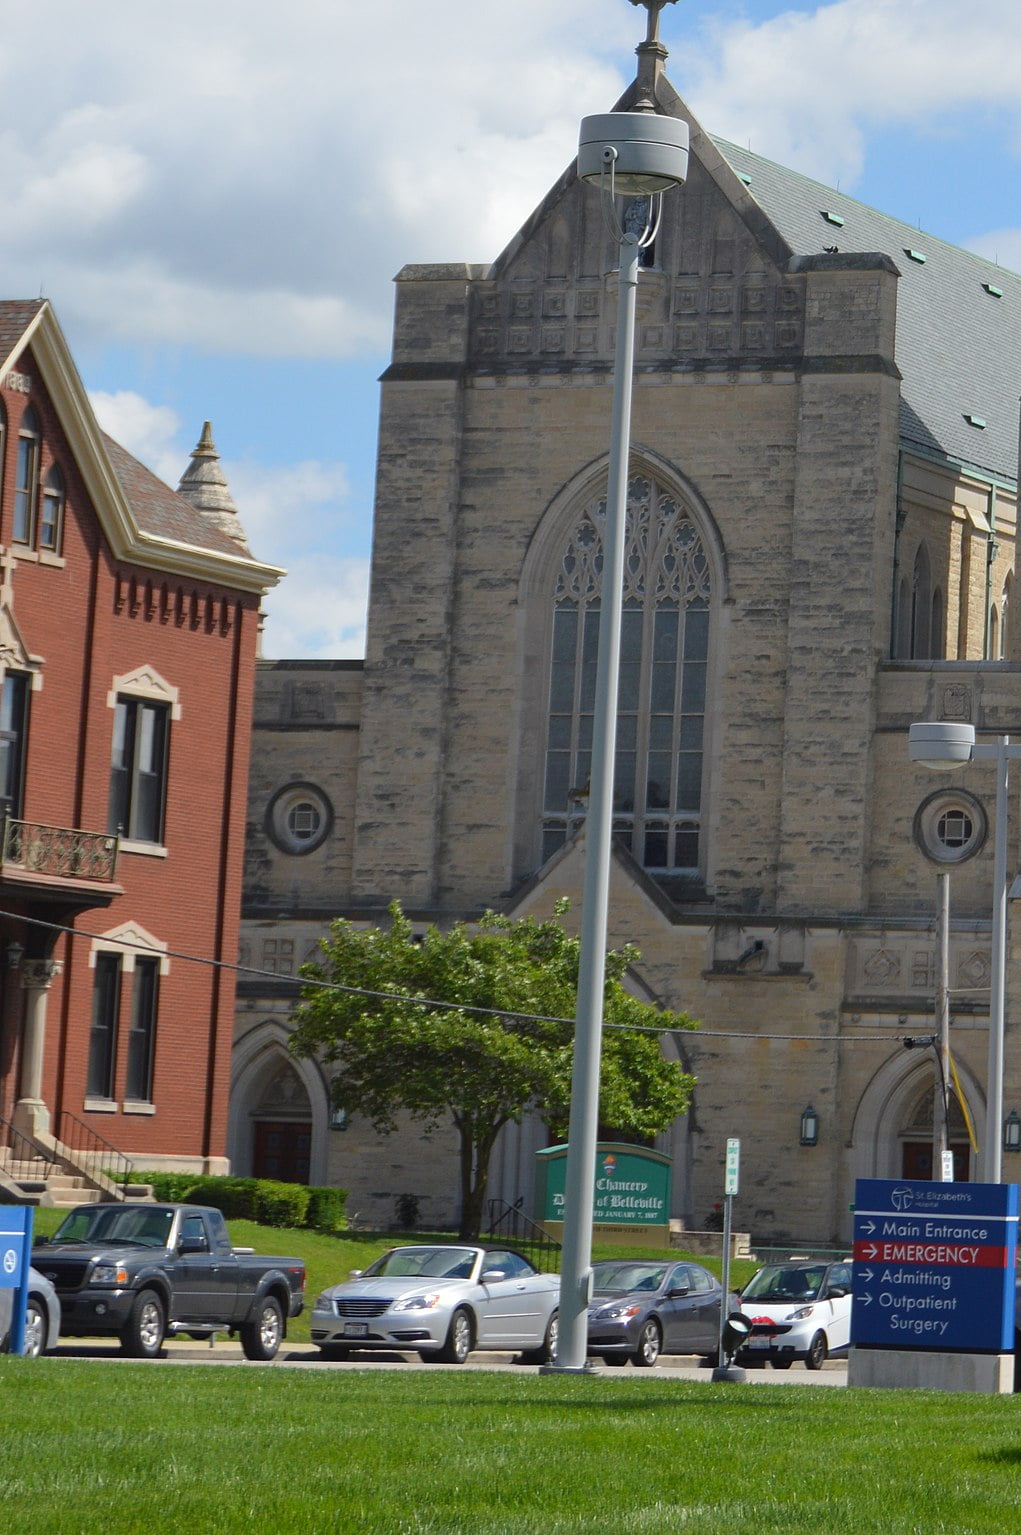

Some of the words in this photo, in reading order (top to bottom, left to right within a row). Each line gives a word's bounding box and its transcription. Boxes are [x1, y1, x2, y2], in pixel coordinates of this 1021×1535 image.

[596, 1177, 648, 1193] Chancery
[596, 1196, 608, 1207] of
[610, 1195, 664, 1210] Belleville
[926, 1191, 972, 1201] Elizabeth's
[882, 1222, 920, 1237] Main
[925, 1223, 988, 1239] Entrance
[883, 1244, 979, 1264] EMERGENCY
[880, 1268, 951, 1290] Admitting
[879, 1292, 957, 1312] Outpatient
[890, 1314, 949, 1335] Surgery
